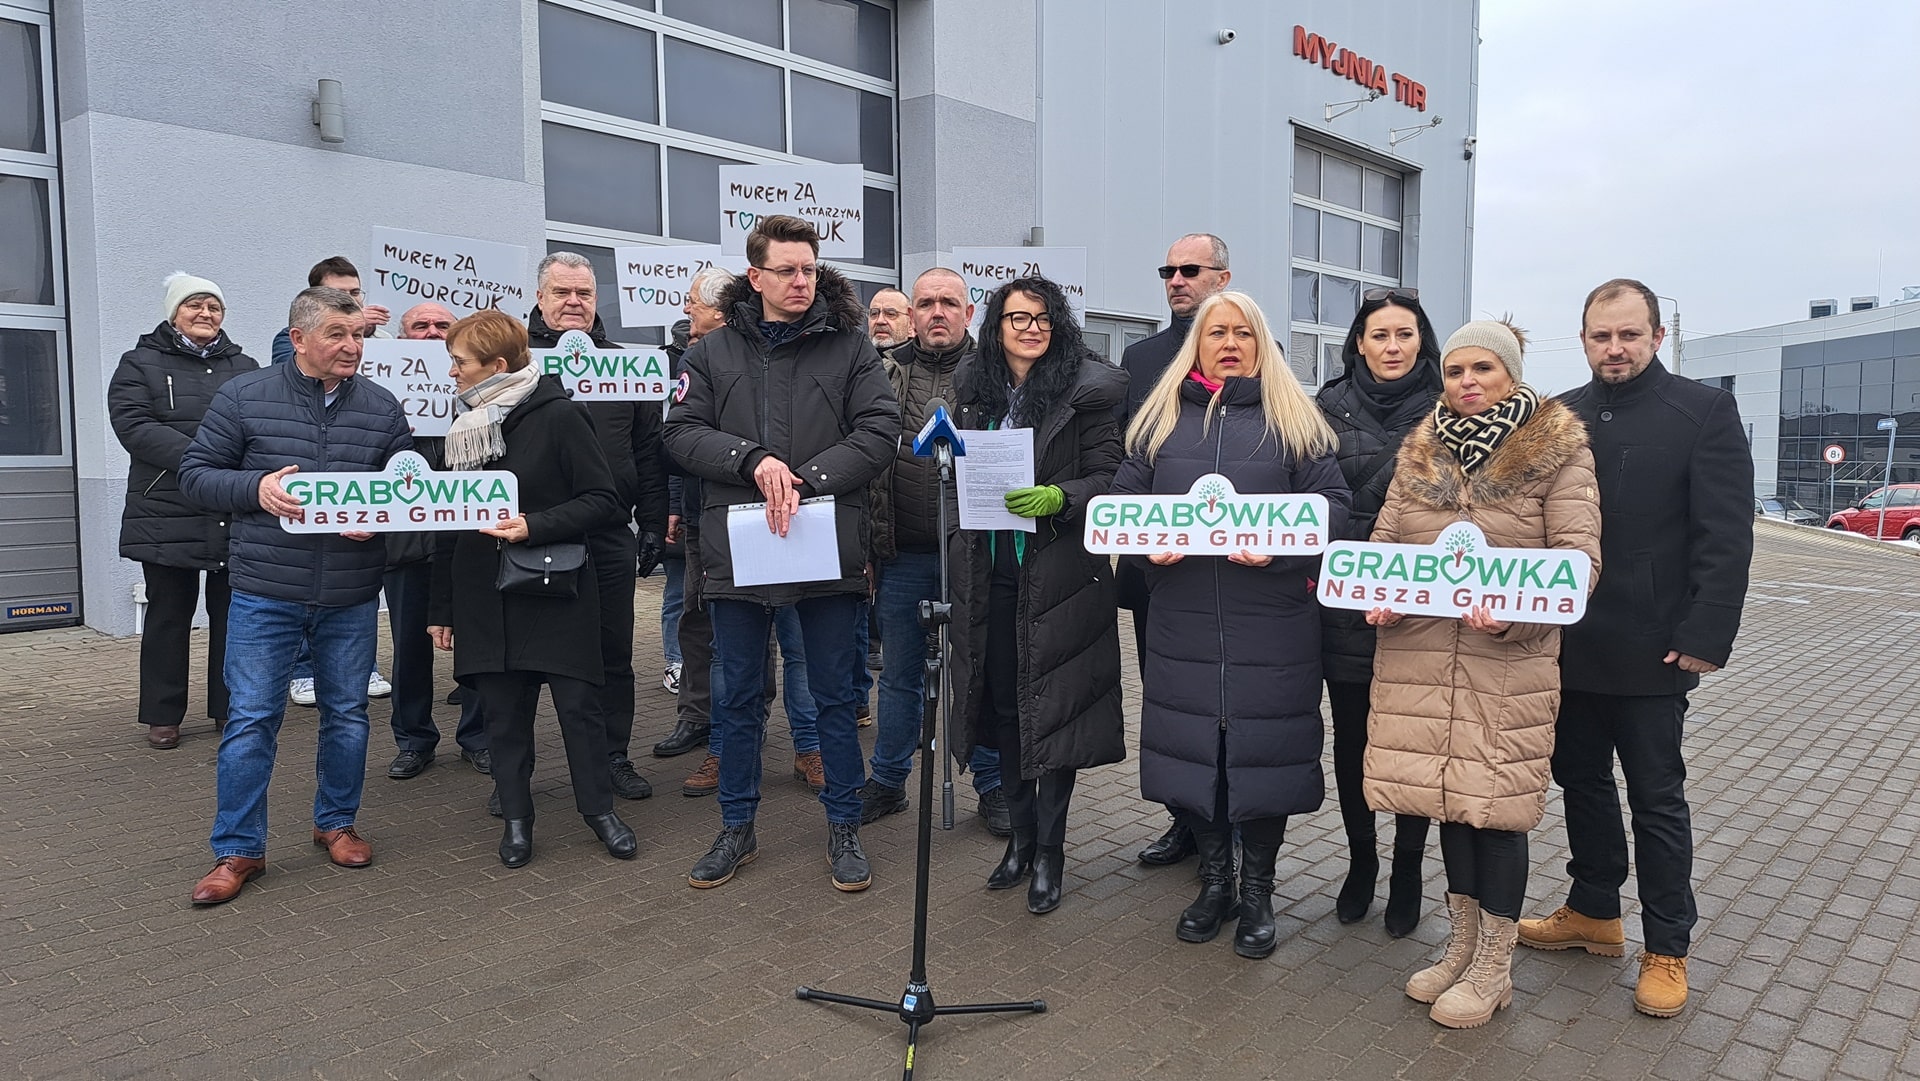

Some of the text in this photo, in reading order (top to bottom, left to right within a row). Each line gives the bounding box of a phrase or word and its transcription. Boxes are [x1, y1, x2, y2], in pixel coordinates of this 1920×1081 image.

[1293, 25, 1426, 111] MYJNIA TIR
[730, 182, 816, 204] MUREM ZA
[798, 207, 861, 222] KATARZYNĄ
[384, 243, 477, 277] MUREM ZA
[627, 262, 688, 279] MUREM
[962, 262, 1041, 280] MUREM ZA
[457, 276, 523, 299] KATARZYNĄ
[400, 357, 431, 382] ZA
[577, 379, 664, 394] Gmina
[409, 505, 511, 523] Gmina
[1091, 529, 1319, 547] Nasza Gmina
[1325, 579, 1431, 605] Nasza
[1452, 587, 1575, 614] Gmina
